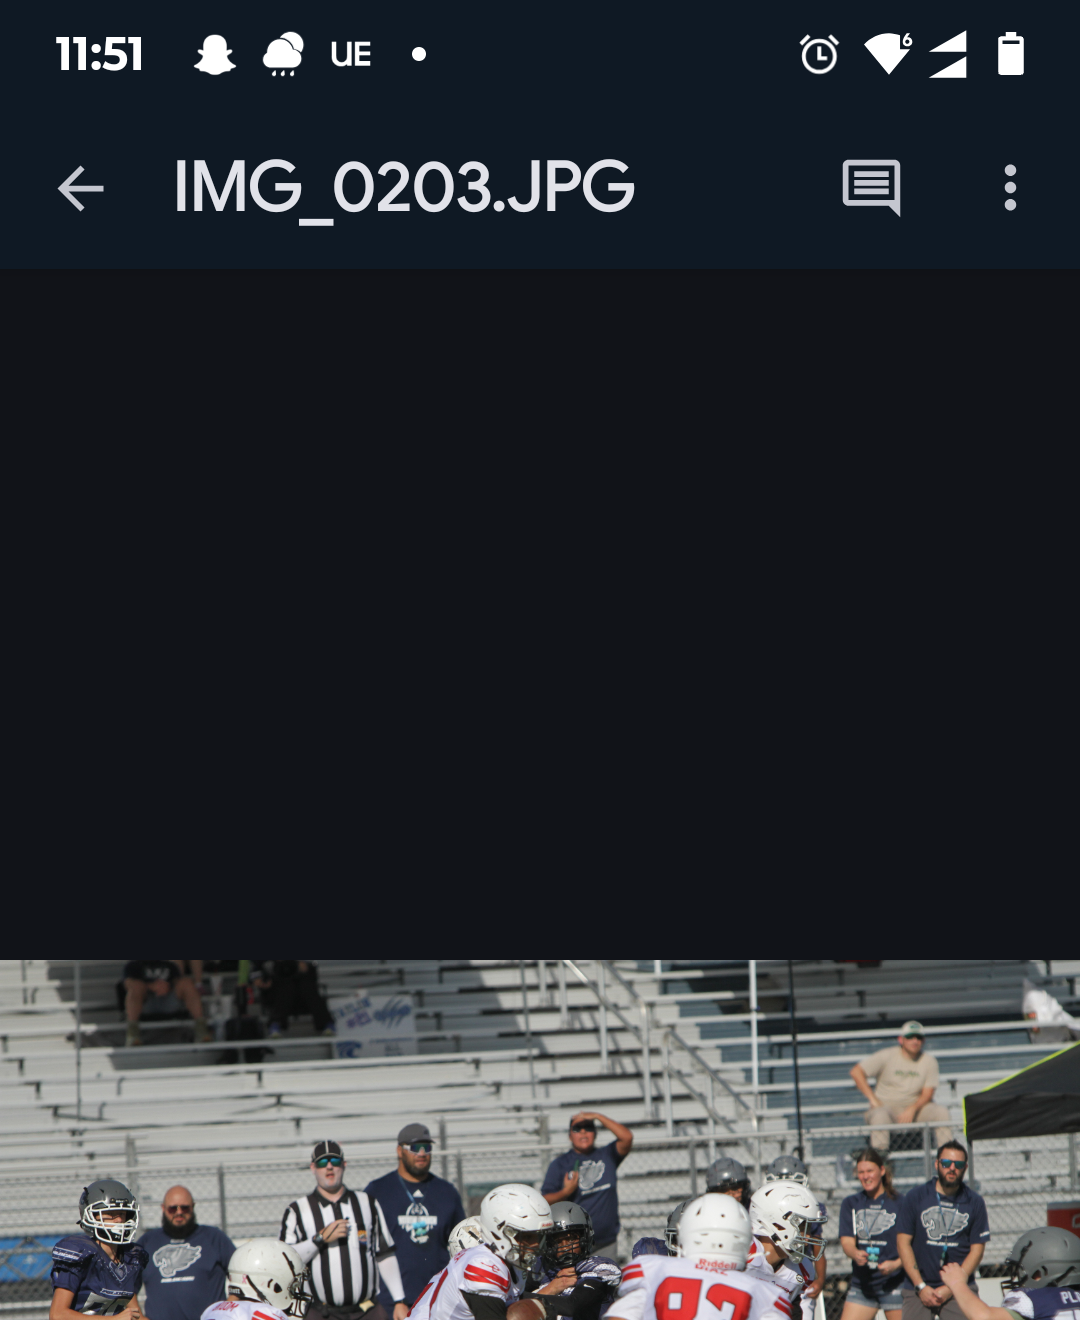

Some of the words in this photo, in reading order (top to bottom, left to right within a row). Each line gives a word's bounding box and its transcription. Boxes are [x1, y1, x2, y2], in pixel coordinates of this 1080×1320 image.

[56, 37, 142, 71] 11:51
[331, 41, 370, 67] UE
[176, 159, 635, 226] IMG_0203.JPG
[699, 1258, 737, 1269] Riddell
